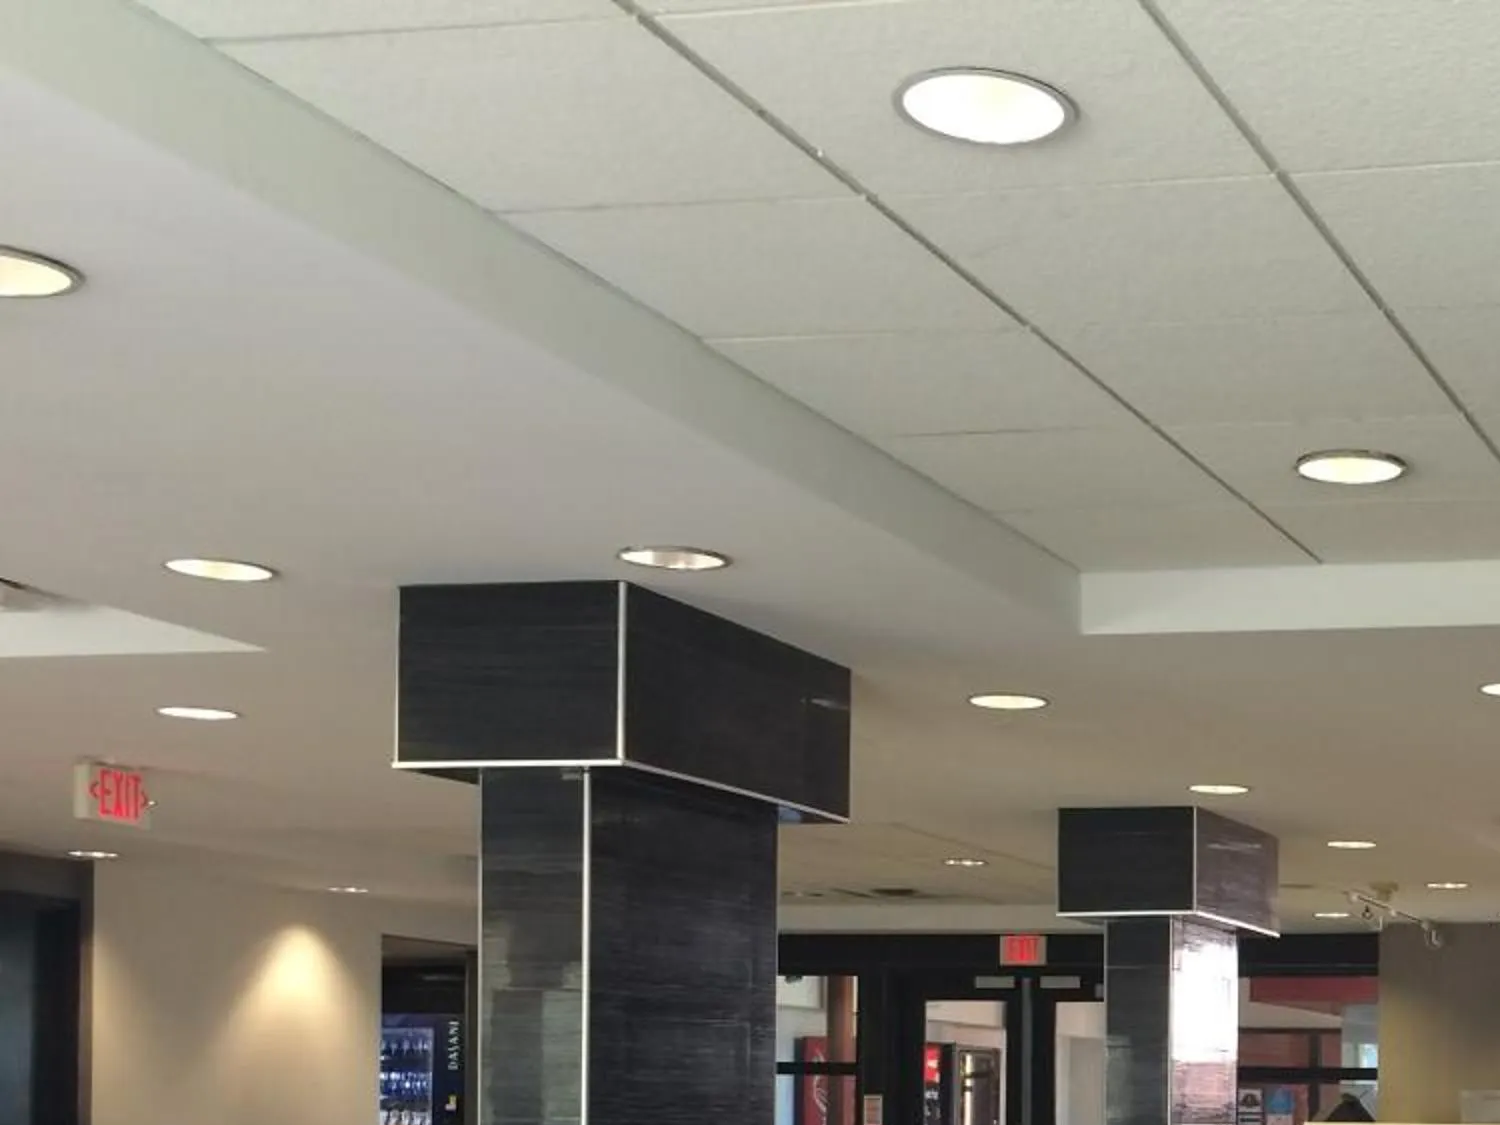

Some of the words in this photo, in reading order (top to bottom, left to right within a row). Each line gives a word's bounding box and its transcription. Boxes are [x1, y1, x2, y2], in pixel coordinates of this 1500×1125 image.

[99, 768, 141, 820] EXIT
[1006, 936, 1039, 961] EXIT
[447, 1021, 460, 1071] DASANI
